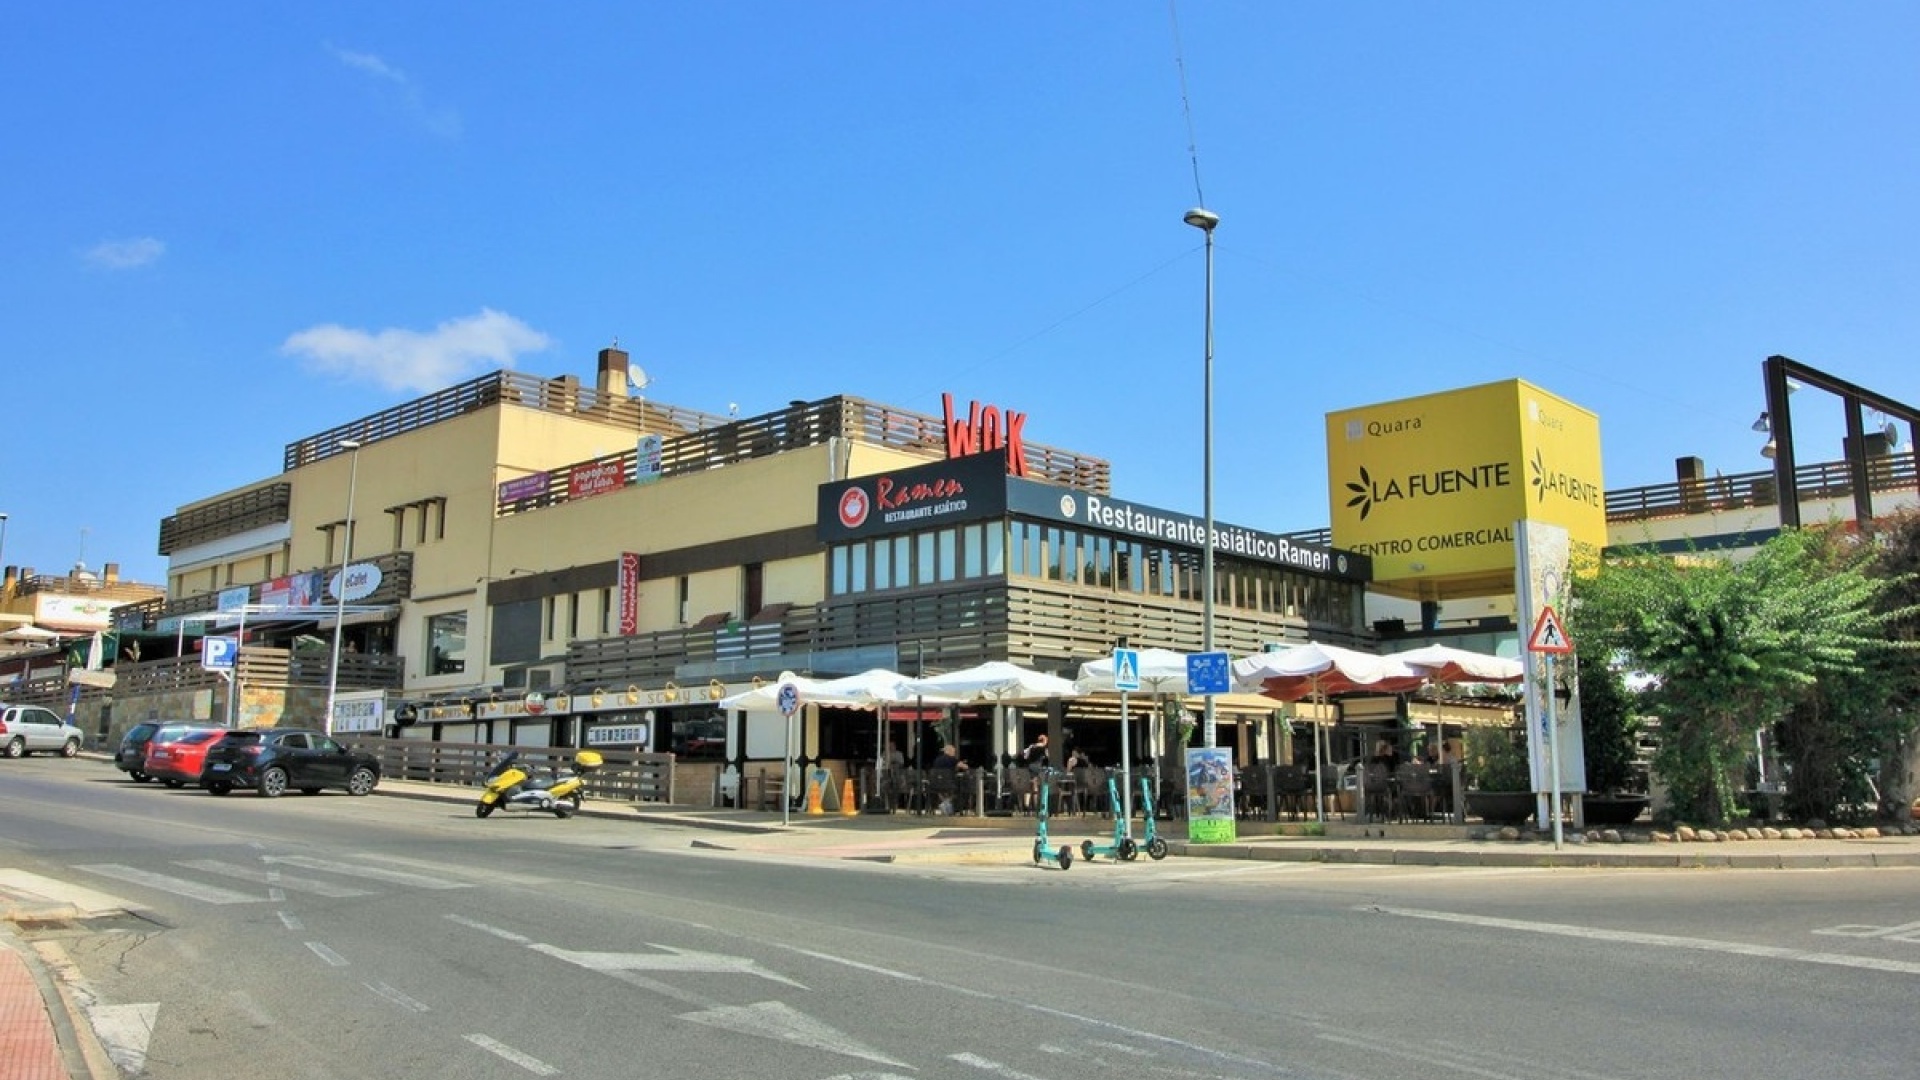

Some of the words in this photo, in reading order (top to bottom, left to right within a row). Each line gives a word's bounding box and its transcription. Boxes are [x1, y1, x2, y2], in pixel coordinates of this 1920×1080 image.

[942, 392, 1029, 477] WOK
[1367, 417, 1422, 437] Quara
[1539, 409, 1563, 431] Quara
[876, 476, 964, 510] Ramen
[1372, 478, 1404, 503] LA
[1409, 462, 1510, 498] FUENTE
[1543, 467, 1558, 493] LA
[1558, 473, 1599, 508] FUENTE
[884, 506, 933, 524] RESTAURANTE
[933, 499, 968, 515] ASIÁTICO
[1087, 496, 1206, 544] Restaurante
[1212, 527, 1276, 558] asiático
[1279, 538, 1331, 570] Ramen
[1417, 527, 1514, 552] COMERCIAL
[206, 640, 228, 666] P
